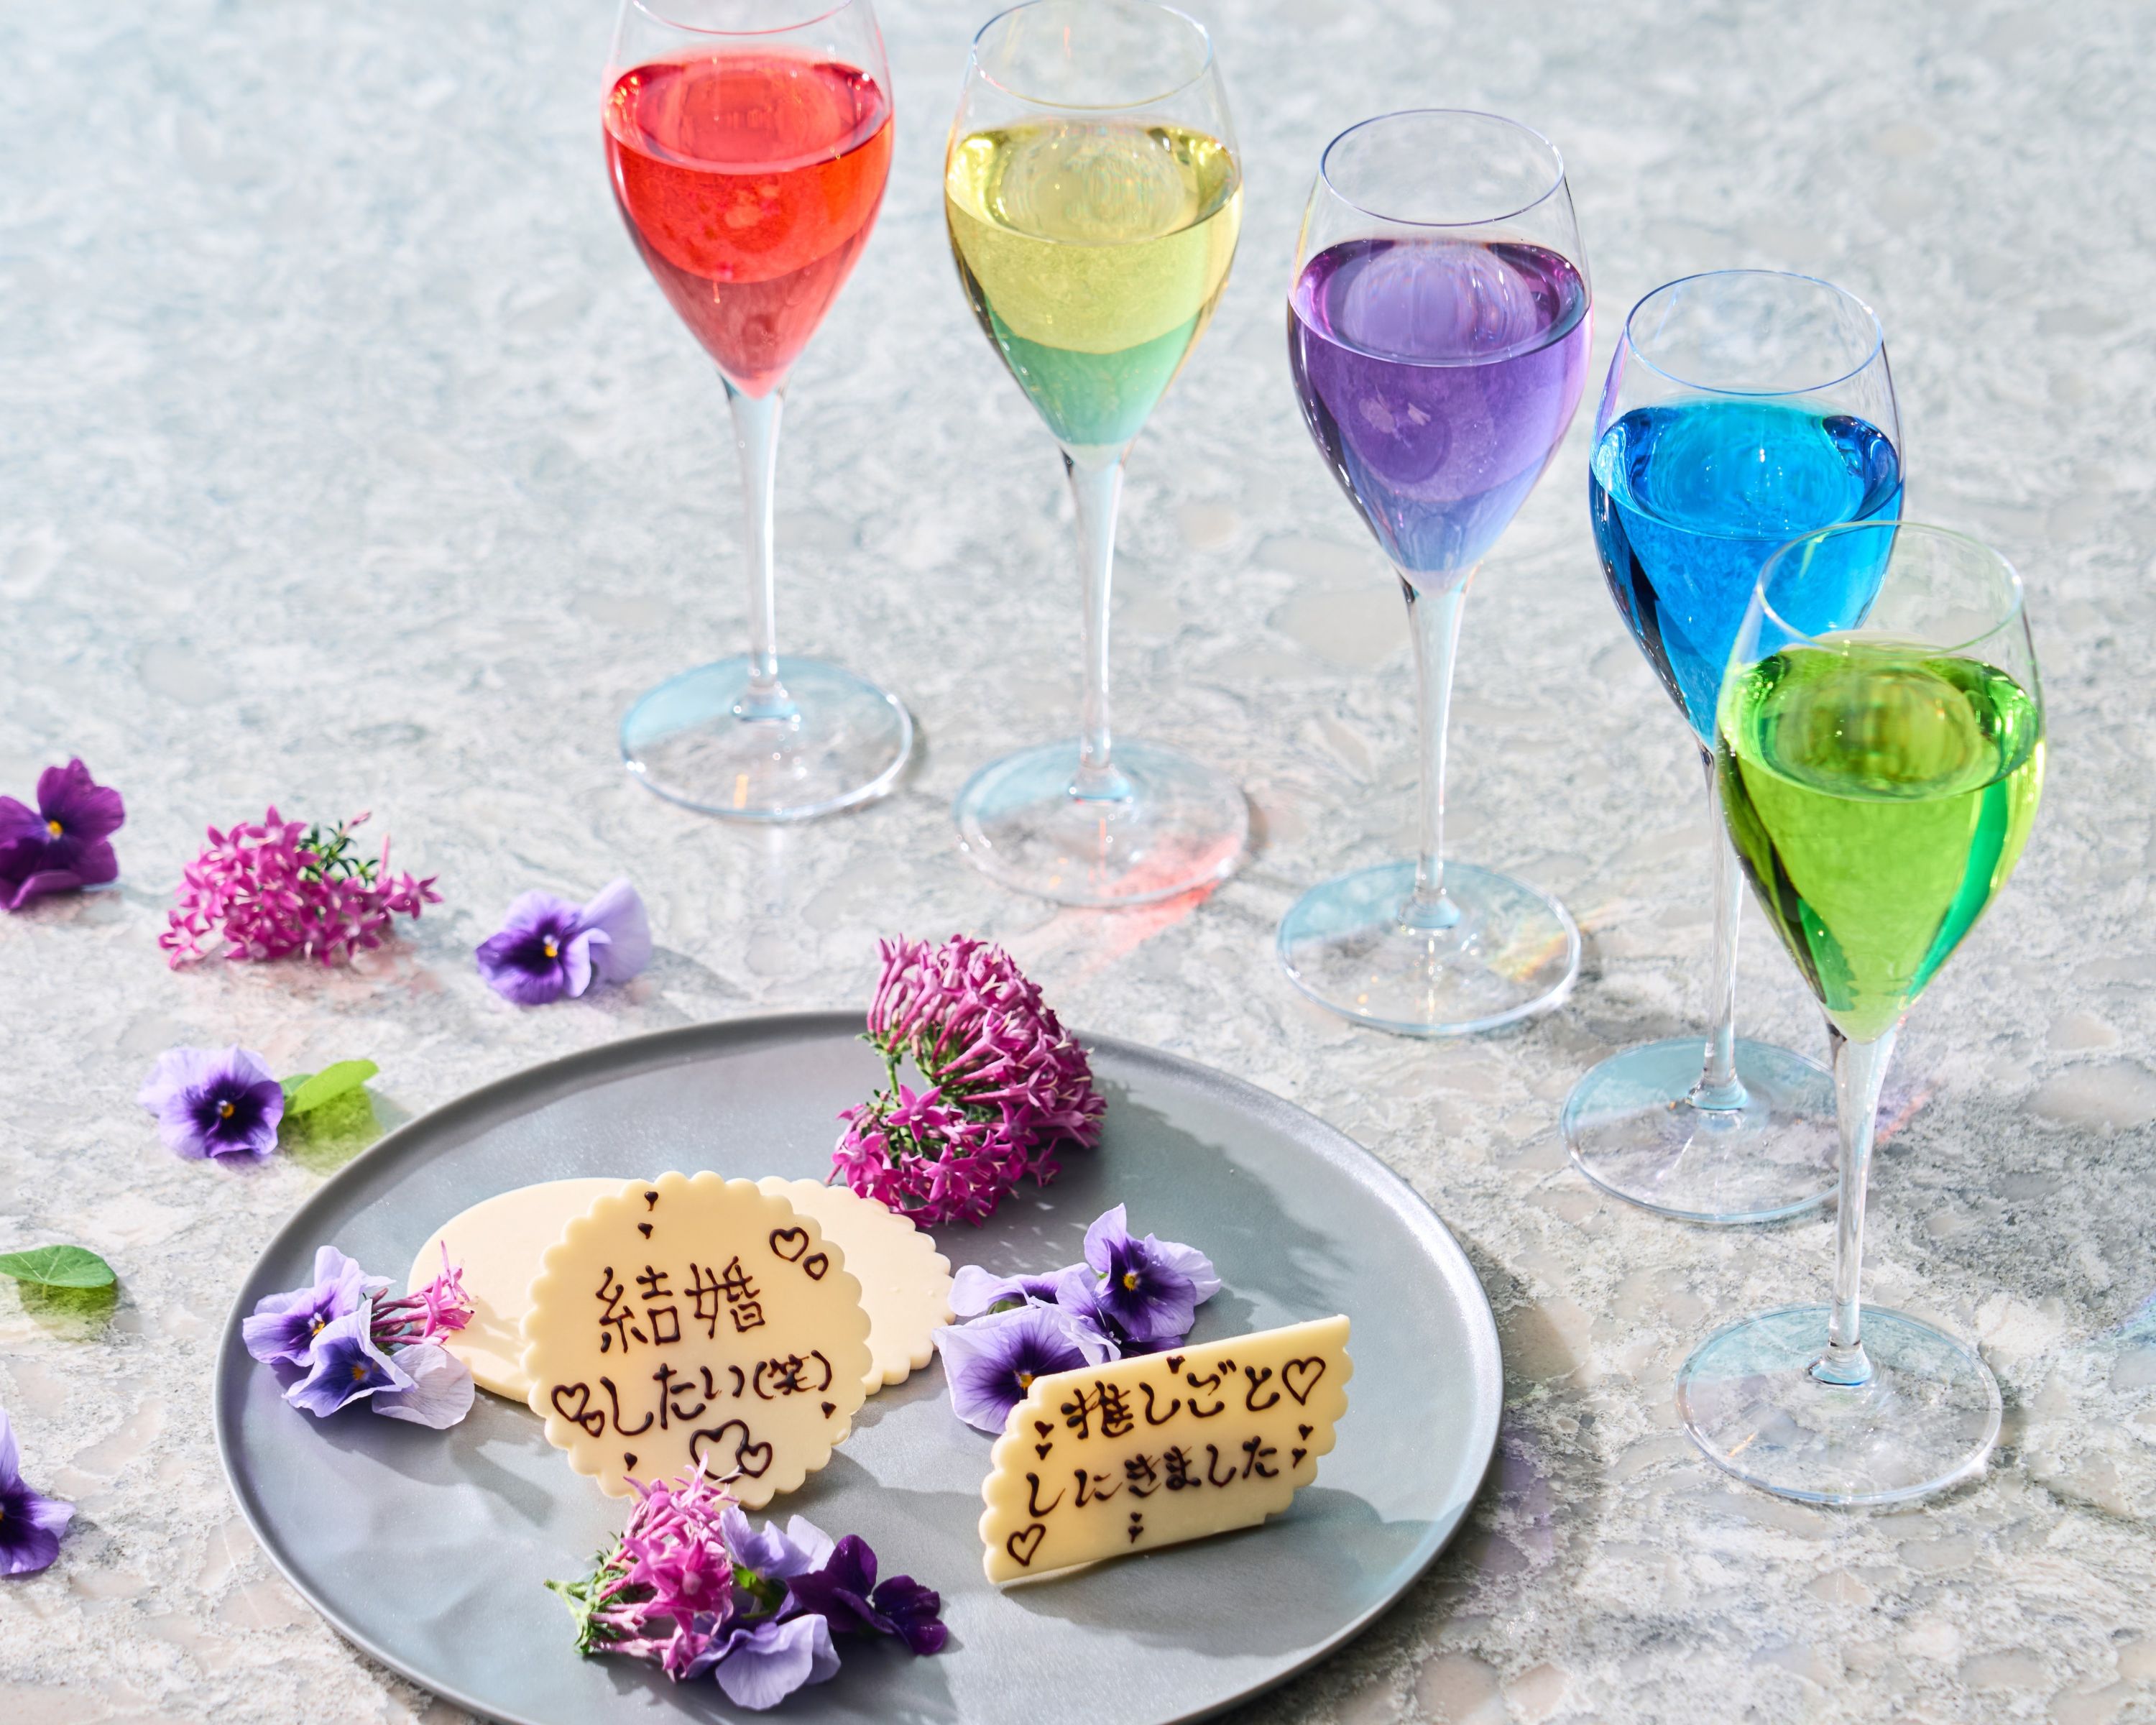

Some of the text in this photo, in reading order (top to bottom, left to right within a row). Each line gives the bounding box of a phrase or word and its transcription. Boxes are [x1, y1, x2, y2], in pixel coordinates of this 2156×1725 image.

[595, 1256, 765, 1353] 結婚
[599, 1350, 831, 1436] したい(笑)
[1061, 1359, 1281, 1439] 推しごと
[1026, 1435, 1279, 1517] しにきました
